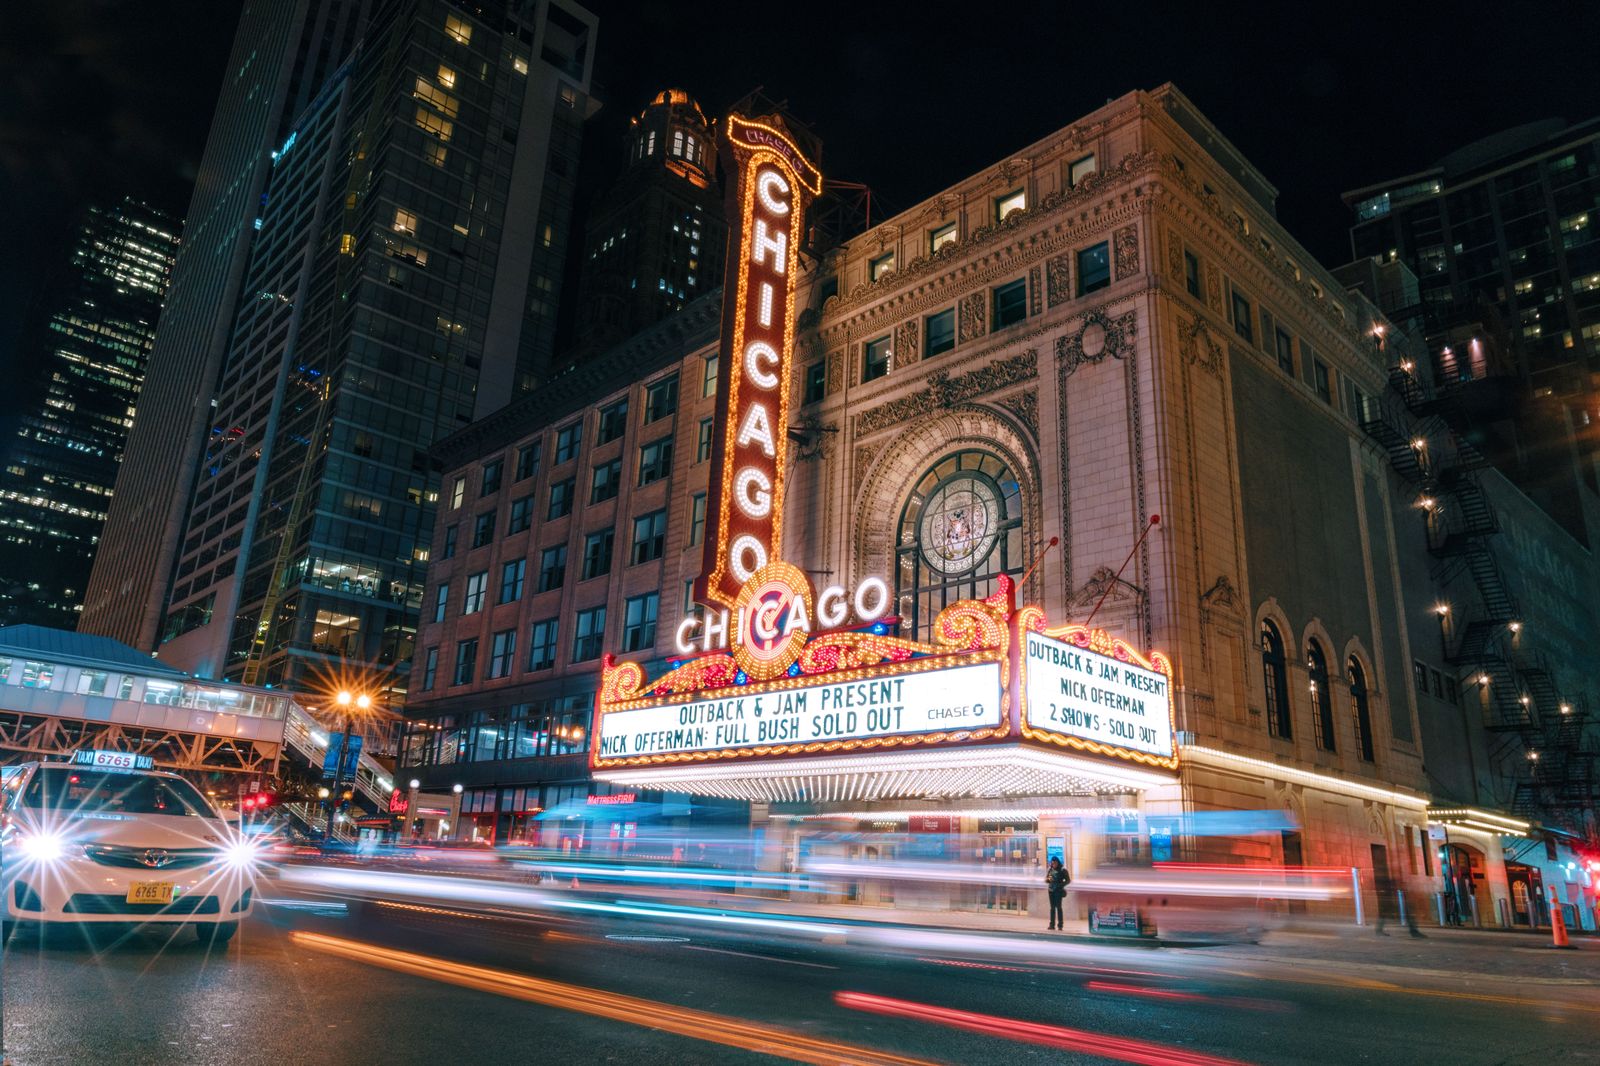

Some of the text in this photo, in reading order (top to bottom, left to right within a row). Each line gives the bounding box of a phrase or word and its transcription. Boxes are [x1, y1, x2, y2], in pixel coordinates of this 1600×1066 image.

[729, 170, 789, 584] CHICAGO
[675, 576, 888, 654] CHICAGO
[1029, 640, 1165, 697] OUTBACK & JAM PRESENT
[679, 679, 905, 725] OUTBACK & JAM PRESENT
[927, 706, 970, 720] CHASE
[1060, 677, 1145, 716] NICK OFFERMAN
[601, 706, 905, 754] NICK OFFERMAN: FULL BUSH SOLD OUT
[1049, 703, 1057, 721] 2
[1060, 706, 1100, 731] SHOWS
[1109, 718, 1134, 739] SOLD
[1139, 726, 1157, 745] OUT
[77, 751, 153, 769] TAXI 6765 TAXI
[135, 886, 172, 898] 6765 TX
